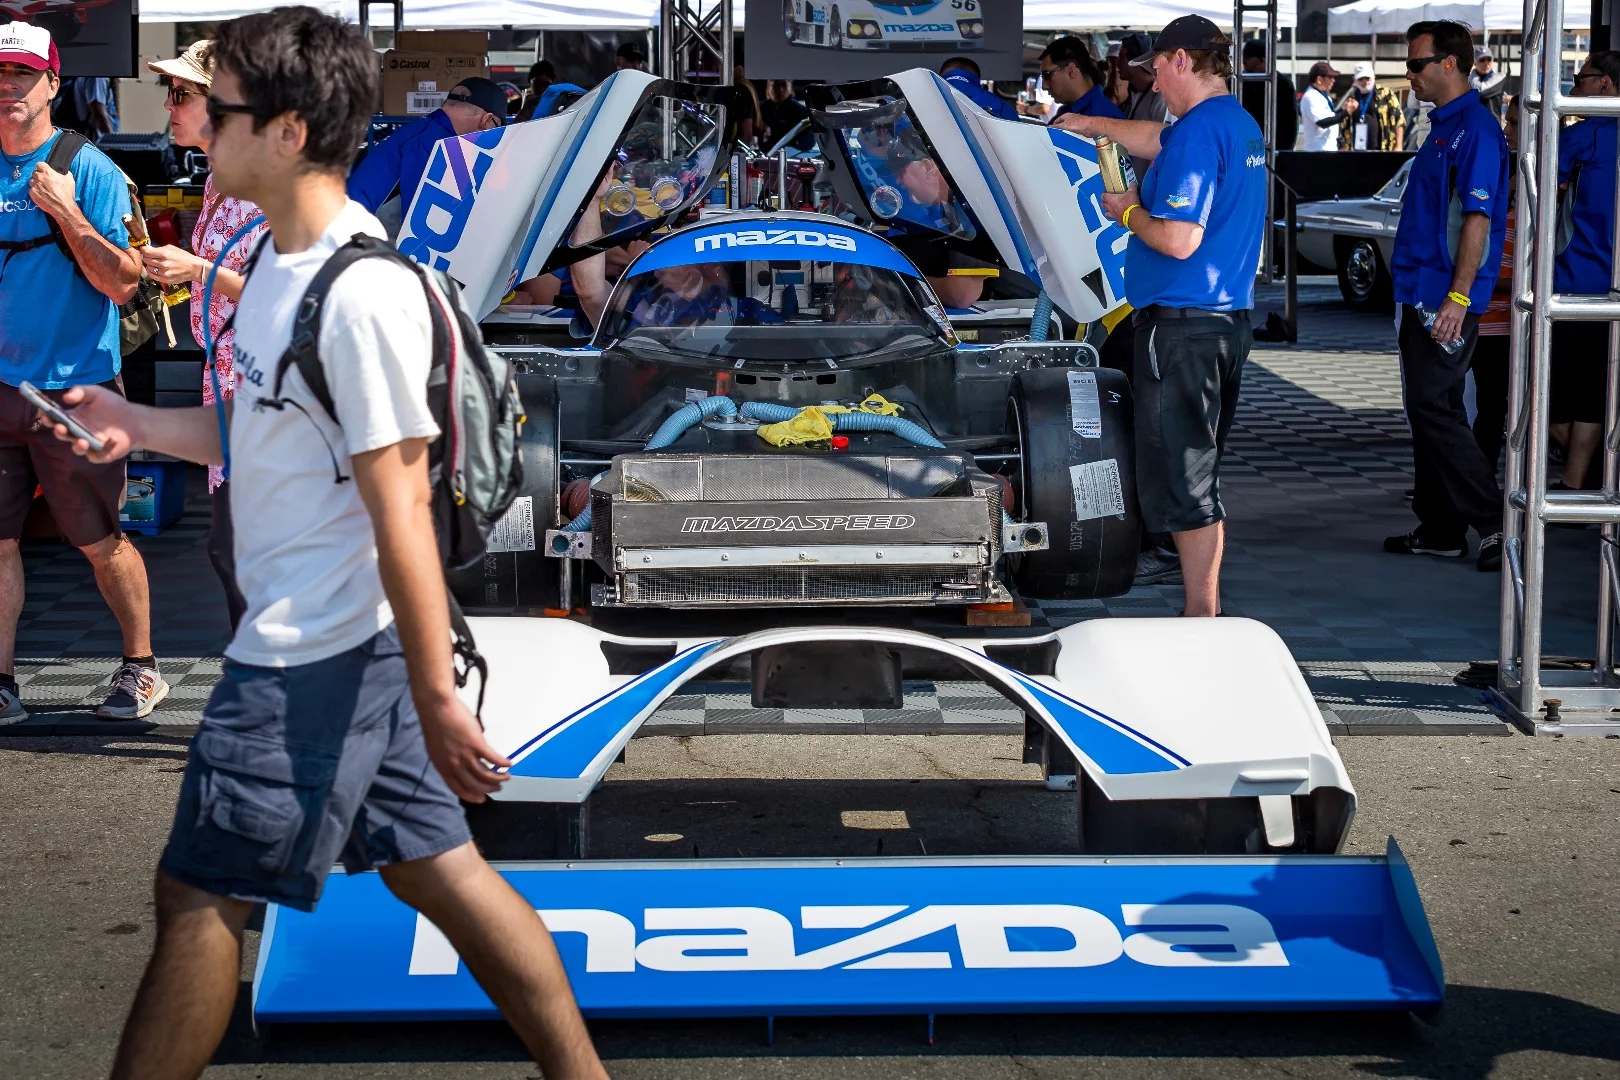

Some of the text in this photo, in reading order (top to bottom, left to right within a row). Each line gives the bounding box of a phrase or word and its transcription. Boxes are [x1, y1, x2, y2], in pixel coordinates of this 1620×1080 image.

[1, 37, 26, 46] FARTED
[399, 60, 431, 69] Castrol
[681, 514, 915, 533] MAZDASPEED
